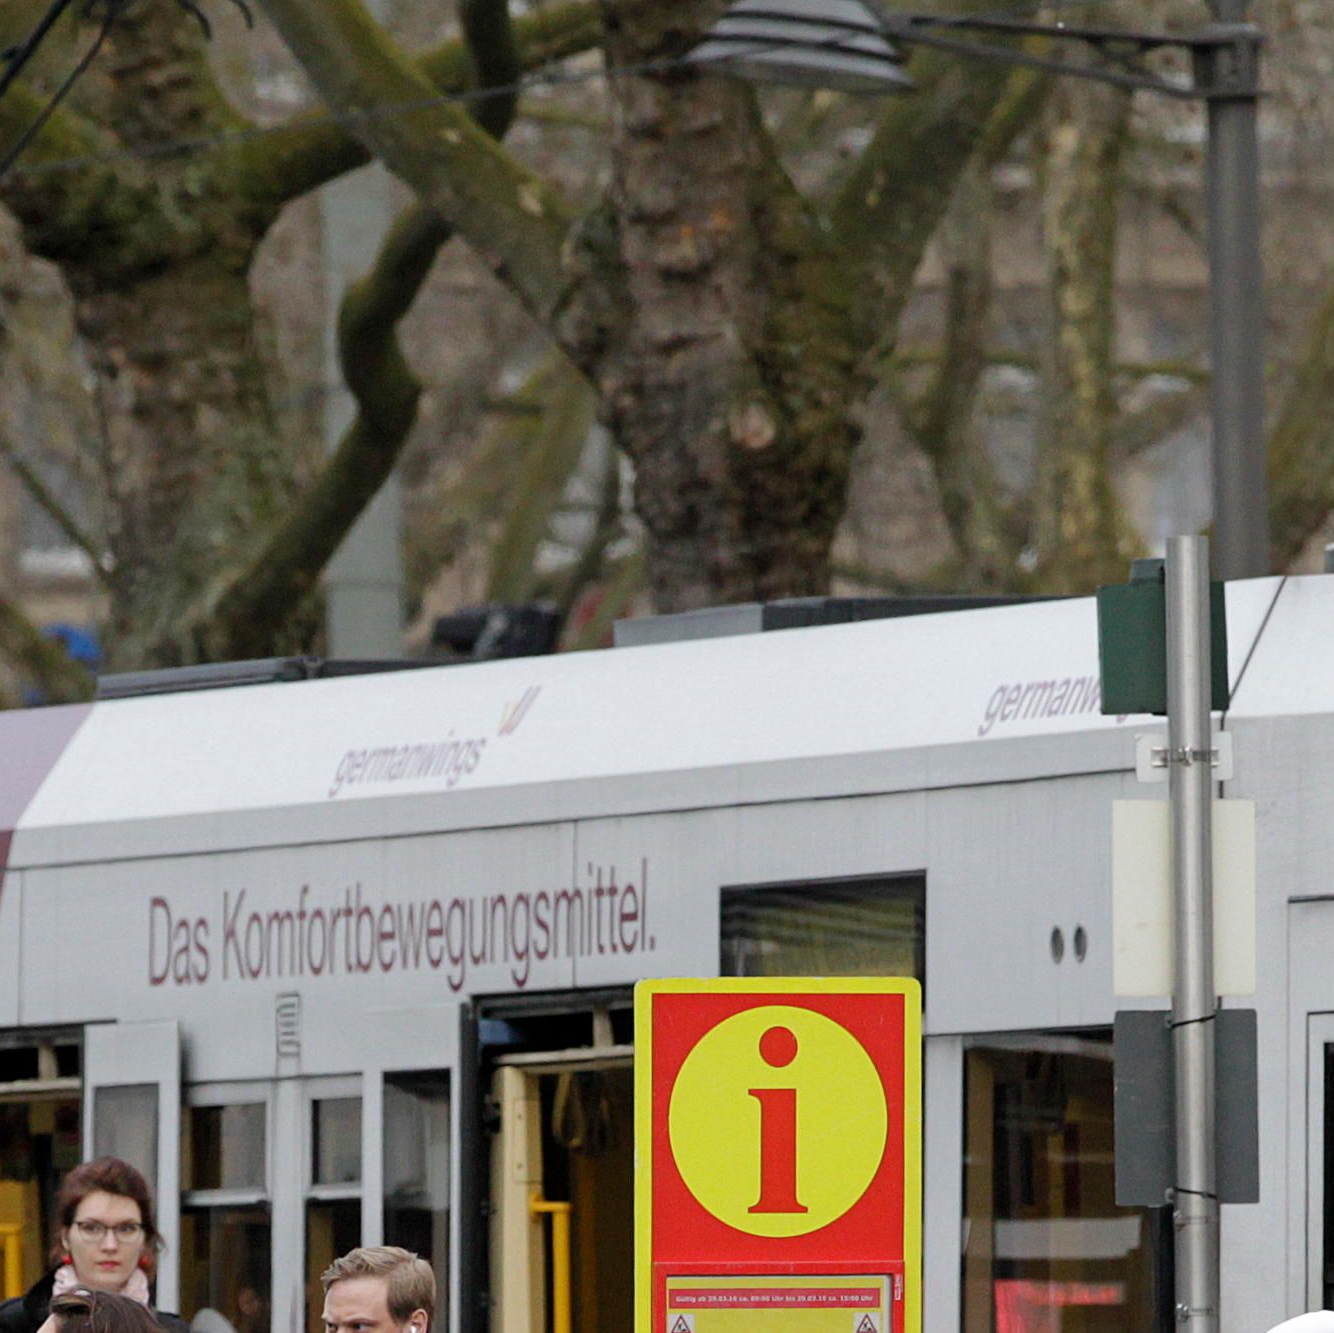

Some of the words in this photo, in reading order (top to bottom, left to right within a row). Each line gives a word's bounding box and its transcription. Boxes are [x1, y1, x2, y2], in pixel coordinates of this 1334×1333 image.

[328, 729, 486, 798] germanwings
[149, 897, 210, 986] Das
[222, 857, 657, 992] Komfortbewegungsmittel.
